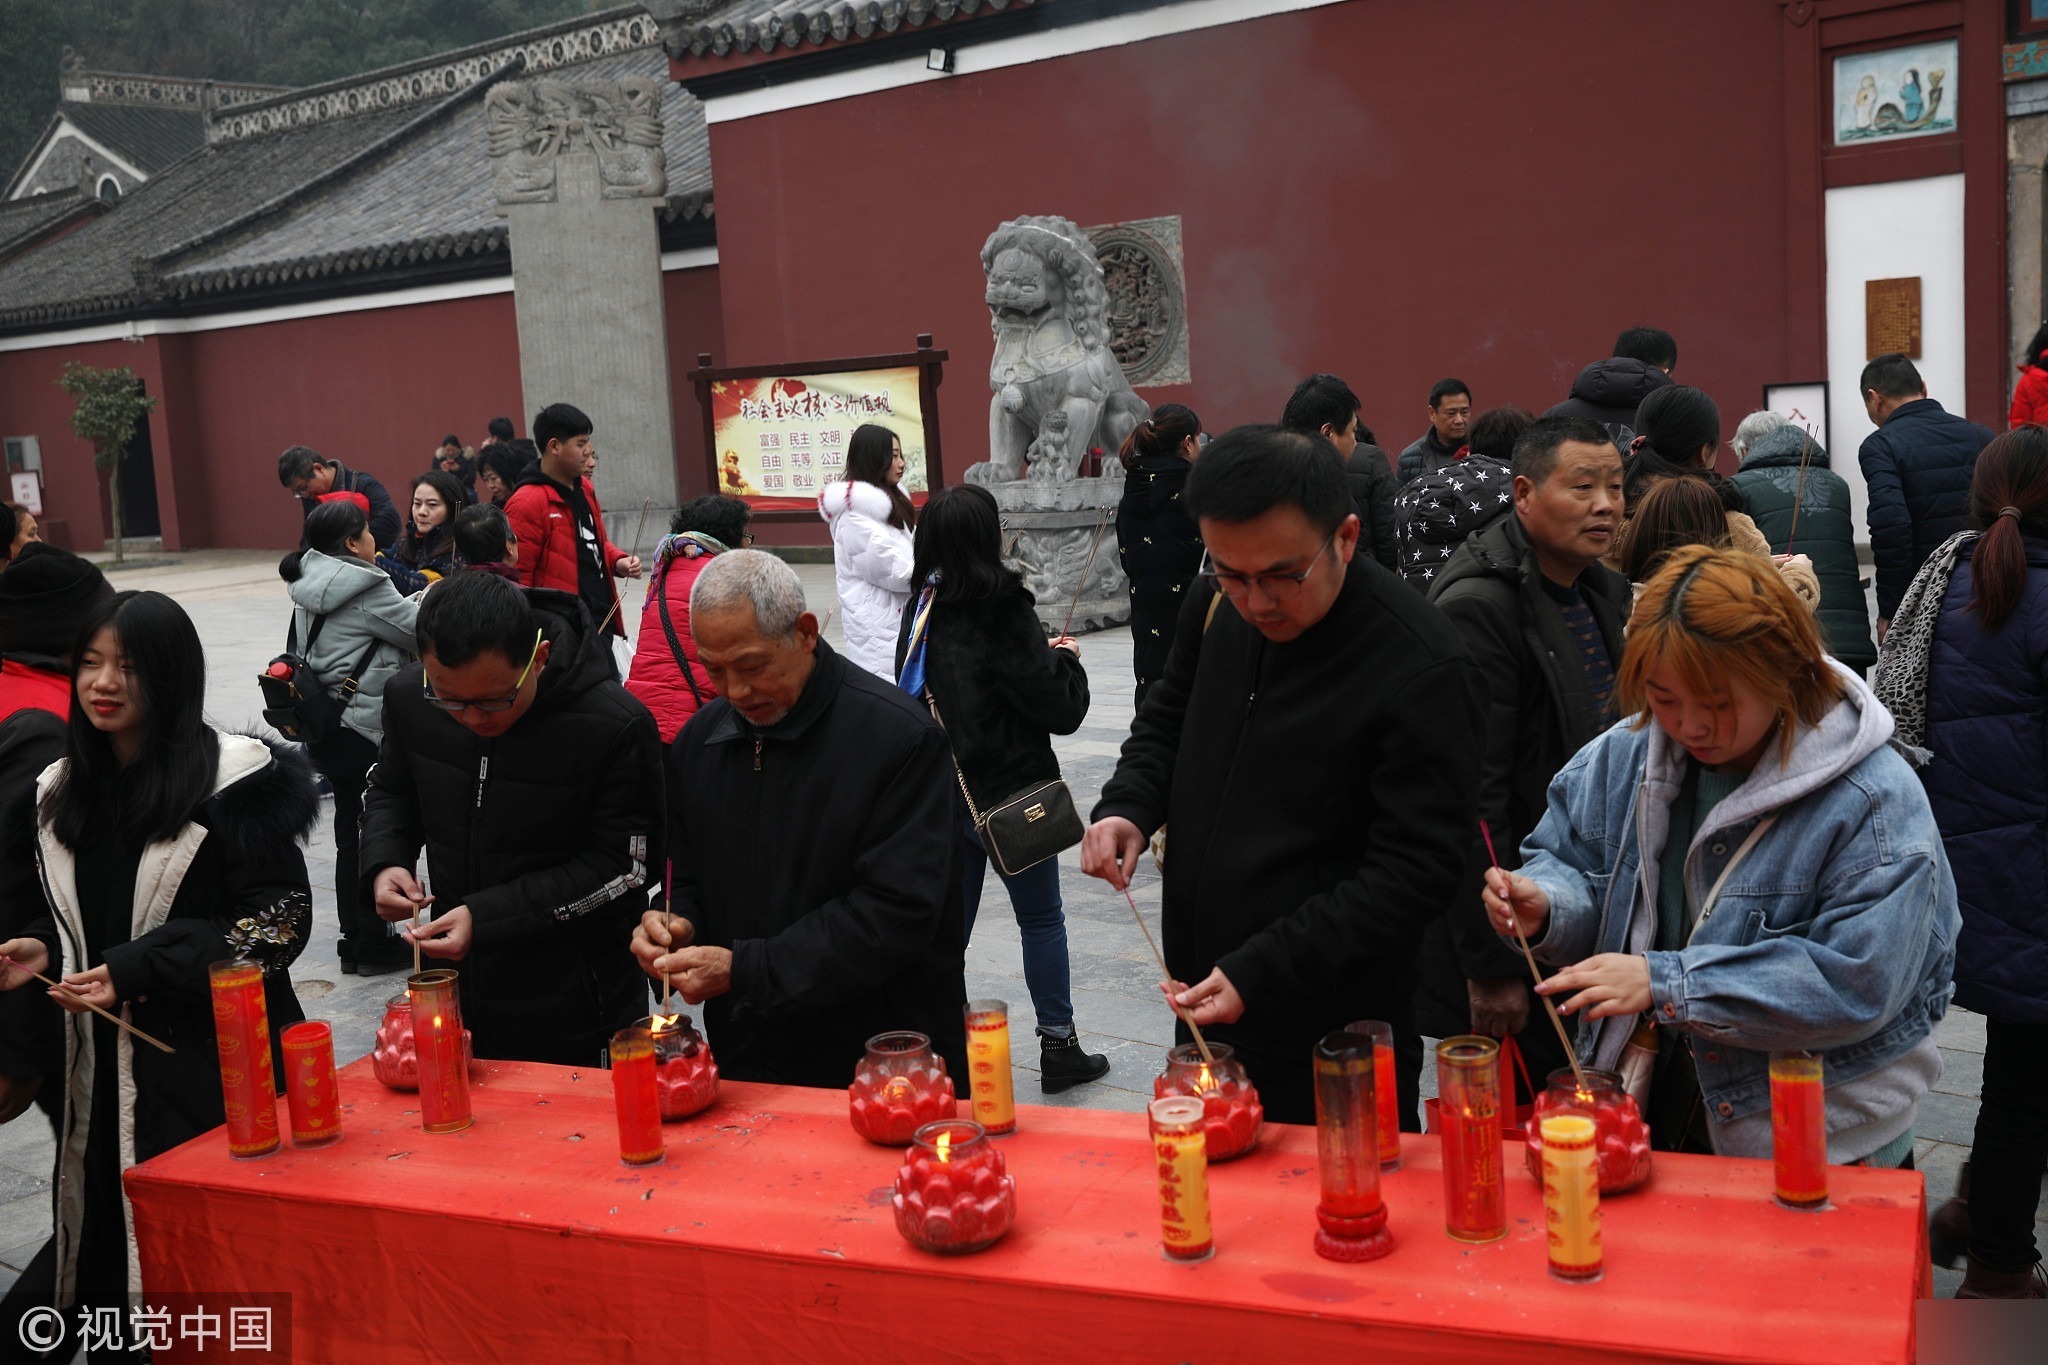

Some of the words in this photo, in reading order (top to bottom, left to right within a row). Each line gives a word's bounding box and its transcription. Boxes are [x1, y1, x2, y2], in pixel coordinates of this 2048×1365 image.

[742, 390, 894, 419] 社会主义核心价值观
[759, 433, 781, 447] 富强
[789, 432, 810, 446] 民主
[819, 430, 841, 444] 文明
[761, 454, 782, 468] 自由
[790, 452, 811, 467] 平等
[820, 451, 842, 465] 公正
[763, 474, 784, 488] 爱国
[792, 473, 814, 487] 敬业
